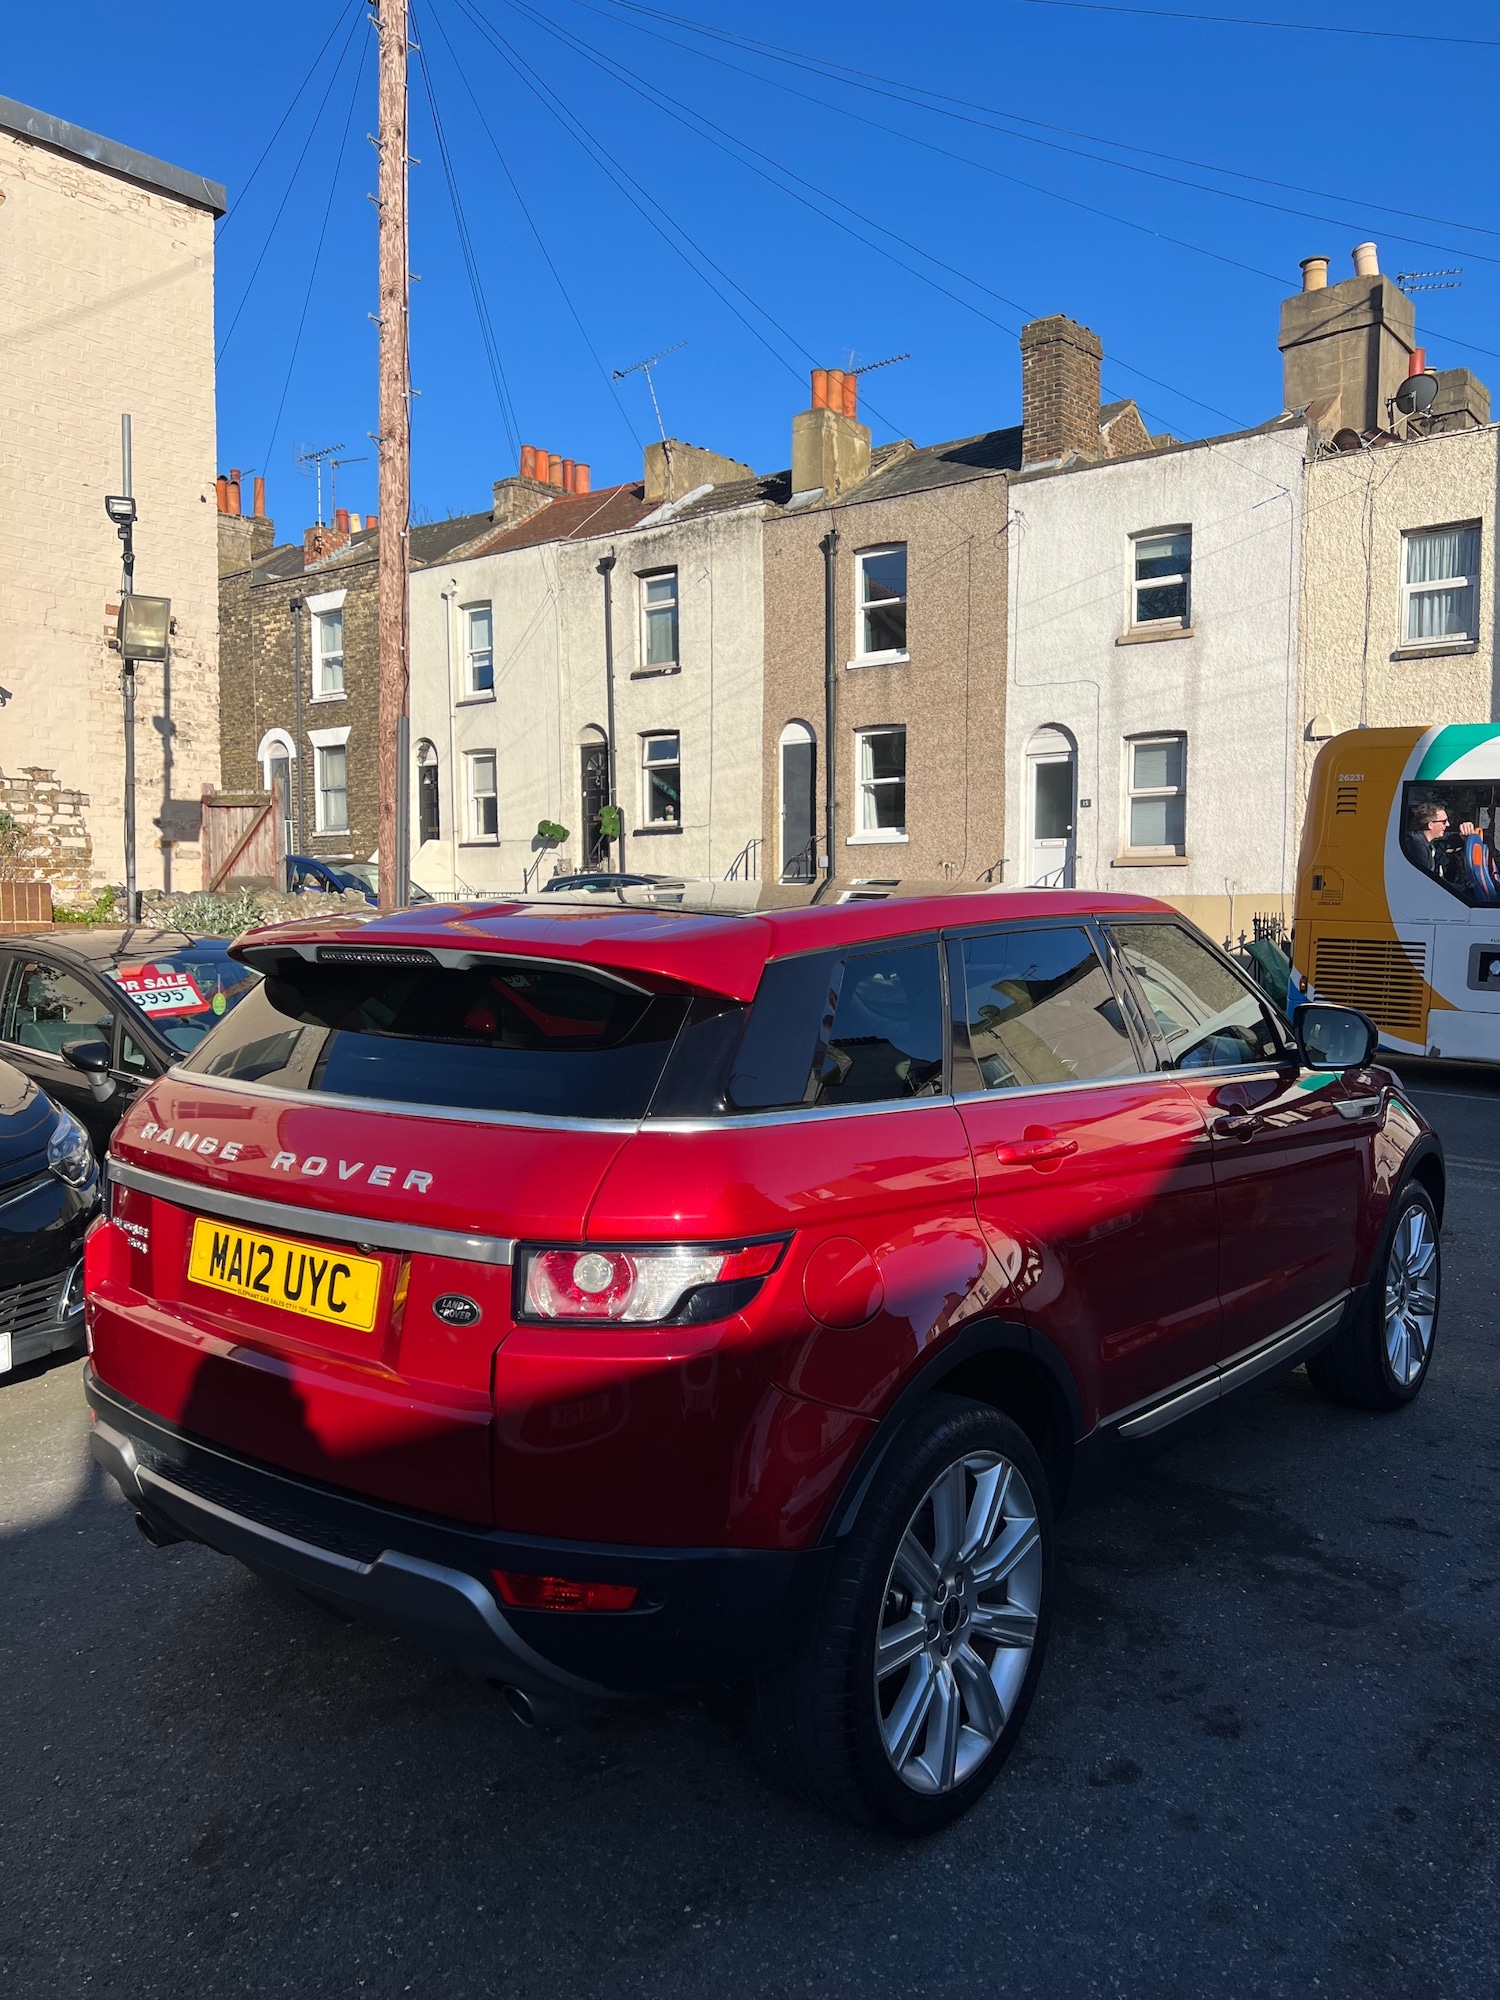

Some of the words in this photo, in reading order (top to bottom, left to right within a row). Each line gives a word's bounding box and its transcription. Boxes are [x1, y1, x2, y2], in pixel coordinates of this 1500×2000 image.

[1338, 773, 1365, 782] 26231
[116, 980, 140, 992] OR
[143, 973, 189, 989] SALE
[140, 1122, 245, 1162] RANGE
[270, 1151, 434, 1194] ROVER
[209, 1231, 275, 1294] MA12
[283, 1251, 351, 1314] UYC
[237, 1288, 260, 1300] ELEPHANT
[270, 1298, 285, 1307] SALES
[441, 1299, 465, 1310] LAND
[443, 1309, 471, 1320] ROVER
